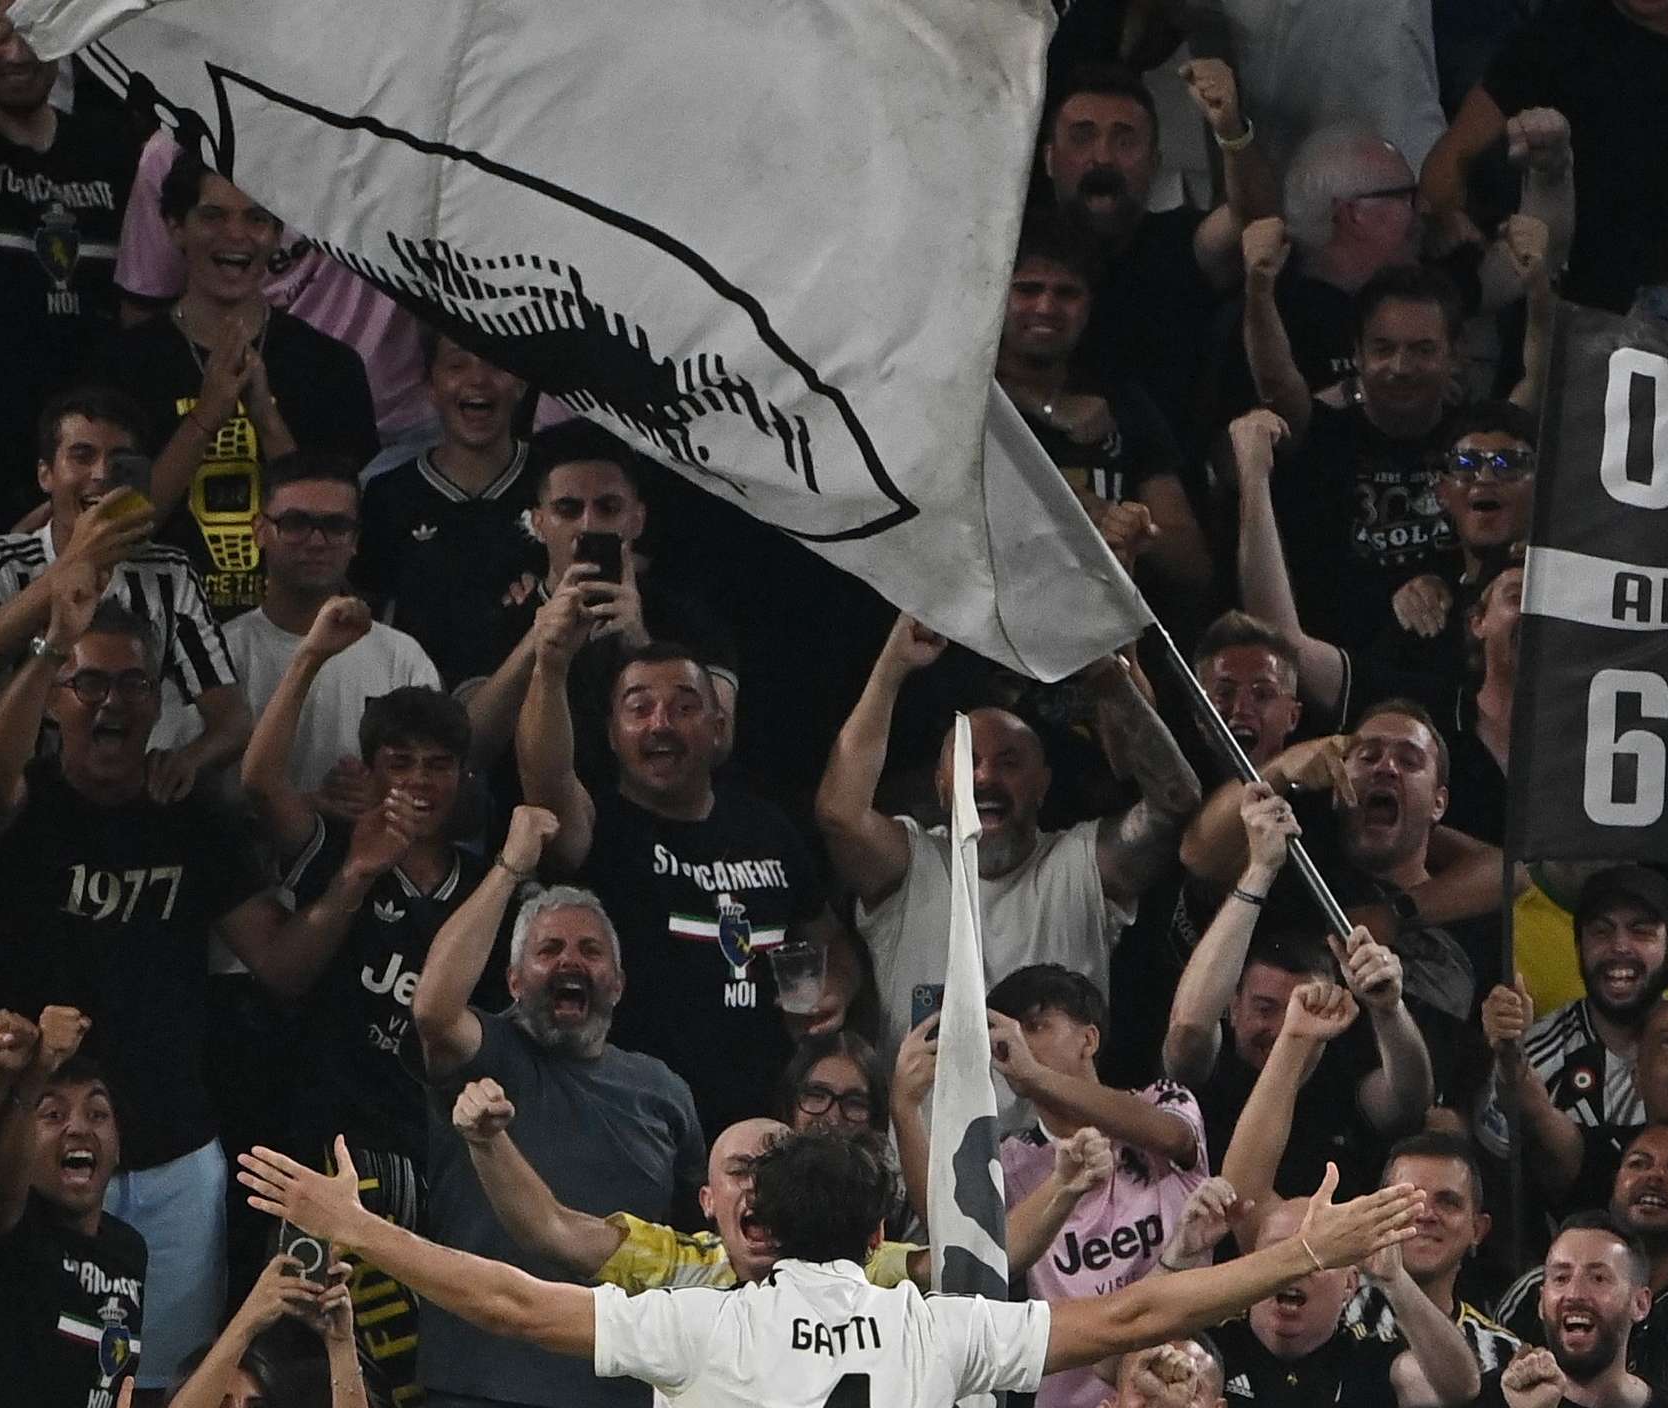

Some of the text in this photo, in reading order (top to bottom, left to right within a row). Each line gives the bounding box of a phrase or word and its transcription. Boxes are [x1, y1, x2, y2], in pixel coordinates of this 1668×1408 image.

[61, 864, 184, 924] 1977
[361, 951, 420, 1007] Je
[724, 980, 757, 1008] NOI
[1053, 1214, 1164, 1276] Jeep
[792, 1316, 881, 1357] GATTI
